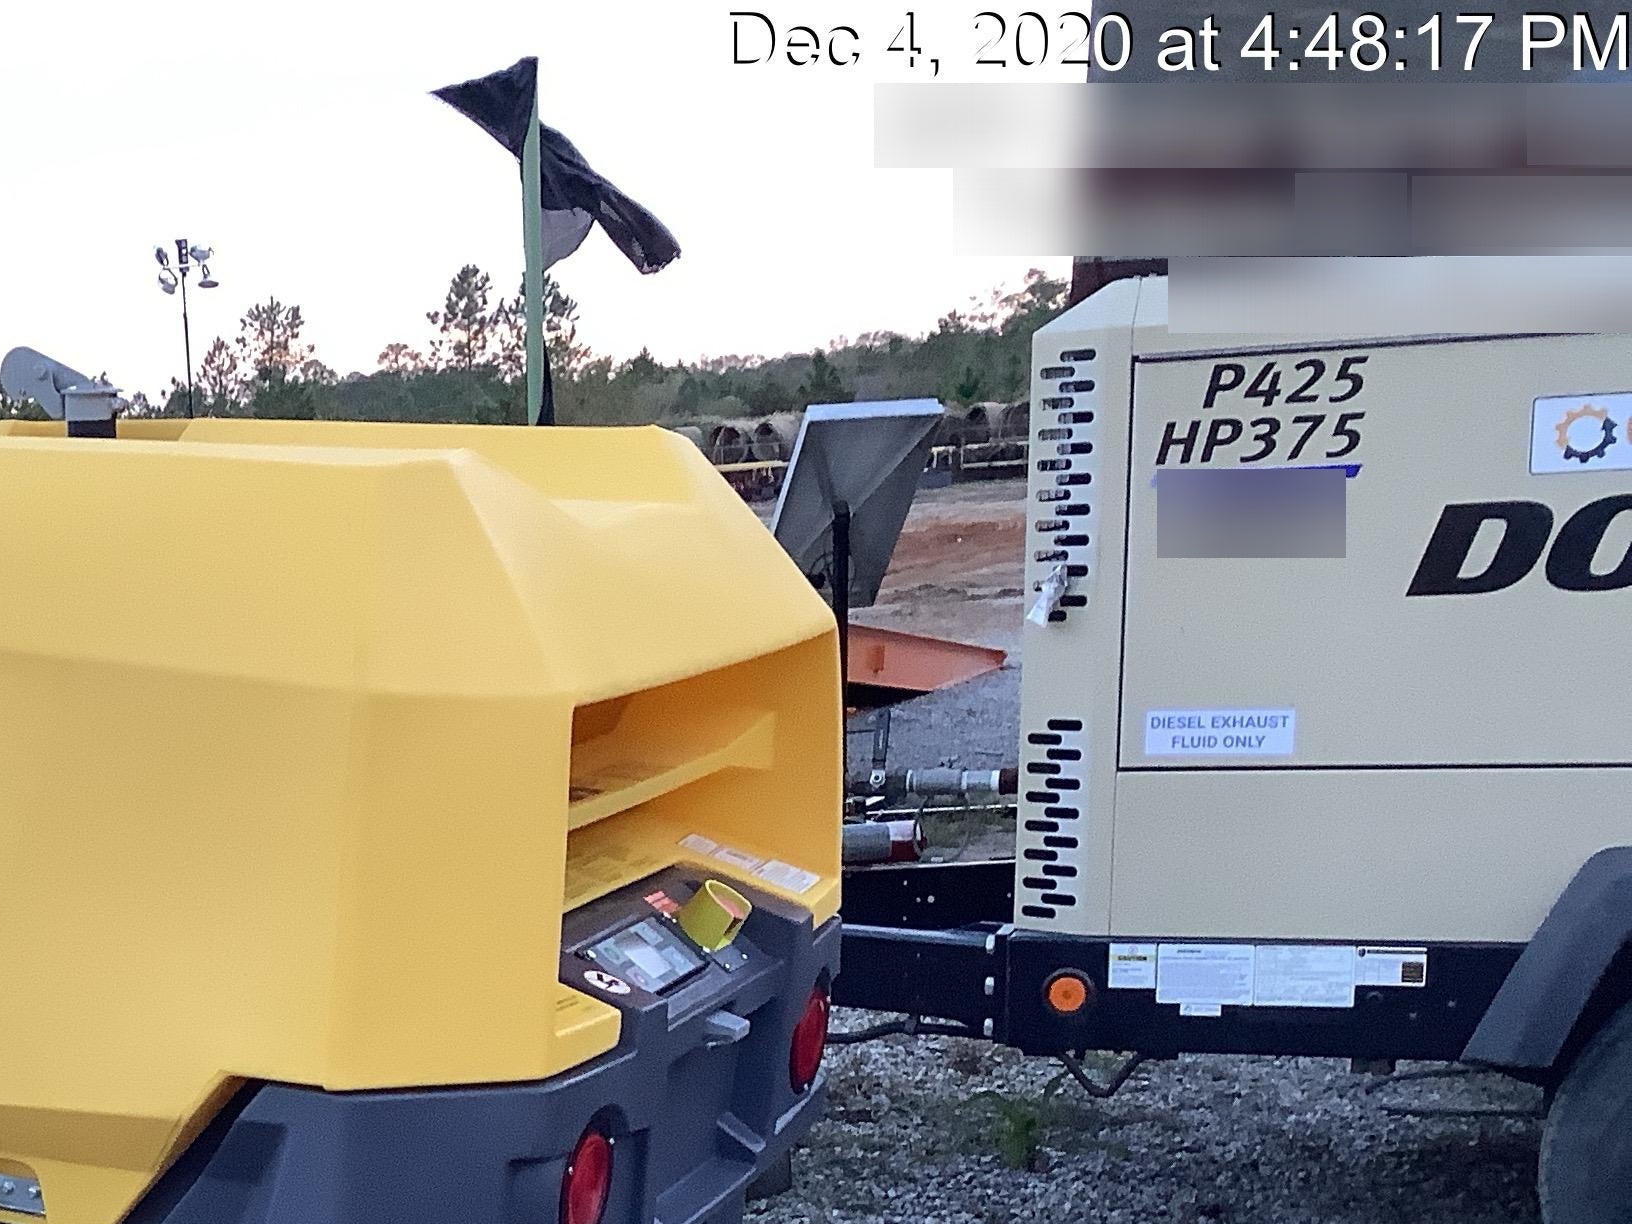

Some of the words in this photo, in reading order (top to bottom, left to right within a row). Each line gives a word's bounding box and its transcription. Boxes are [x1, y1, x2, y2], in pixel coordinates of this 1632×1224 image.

[1202, 355, 1369, 409] P425
[1155, 411, 1366, 466] HP375
[1405, 493, 1632, 597] DO
[1150, 715, 1206, 730] DIESEL
[1211, 714, 1289, 729] EXHAUST
[1171, 735, 1217, 749] FLUID
[1222, 735, 1266, 749] ONLY
